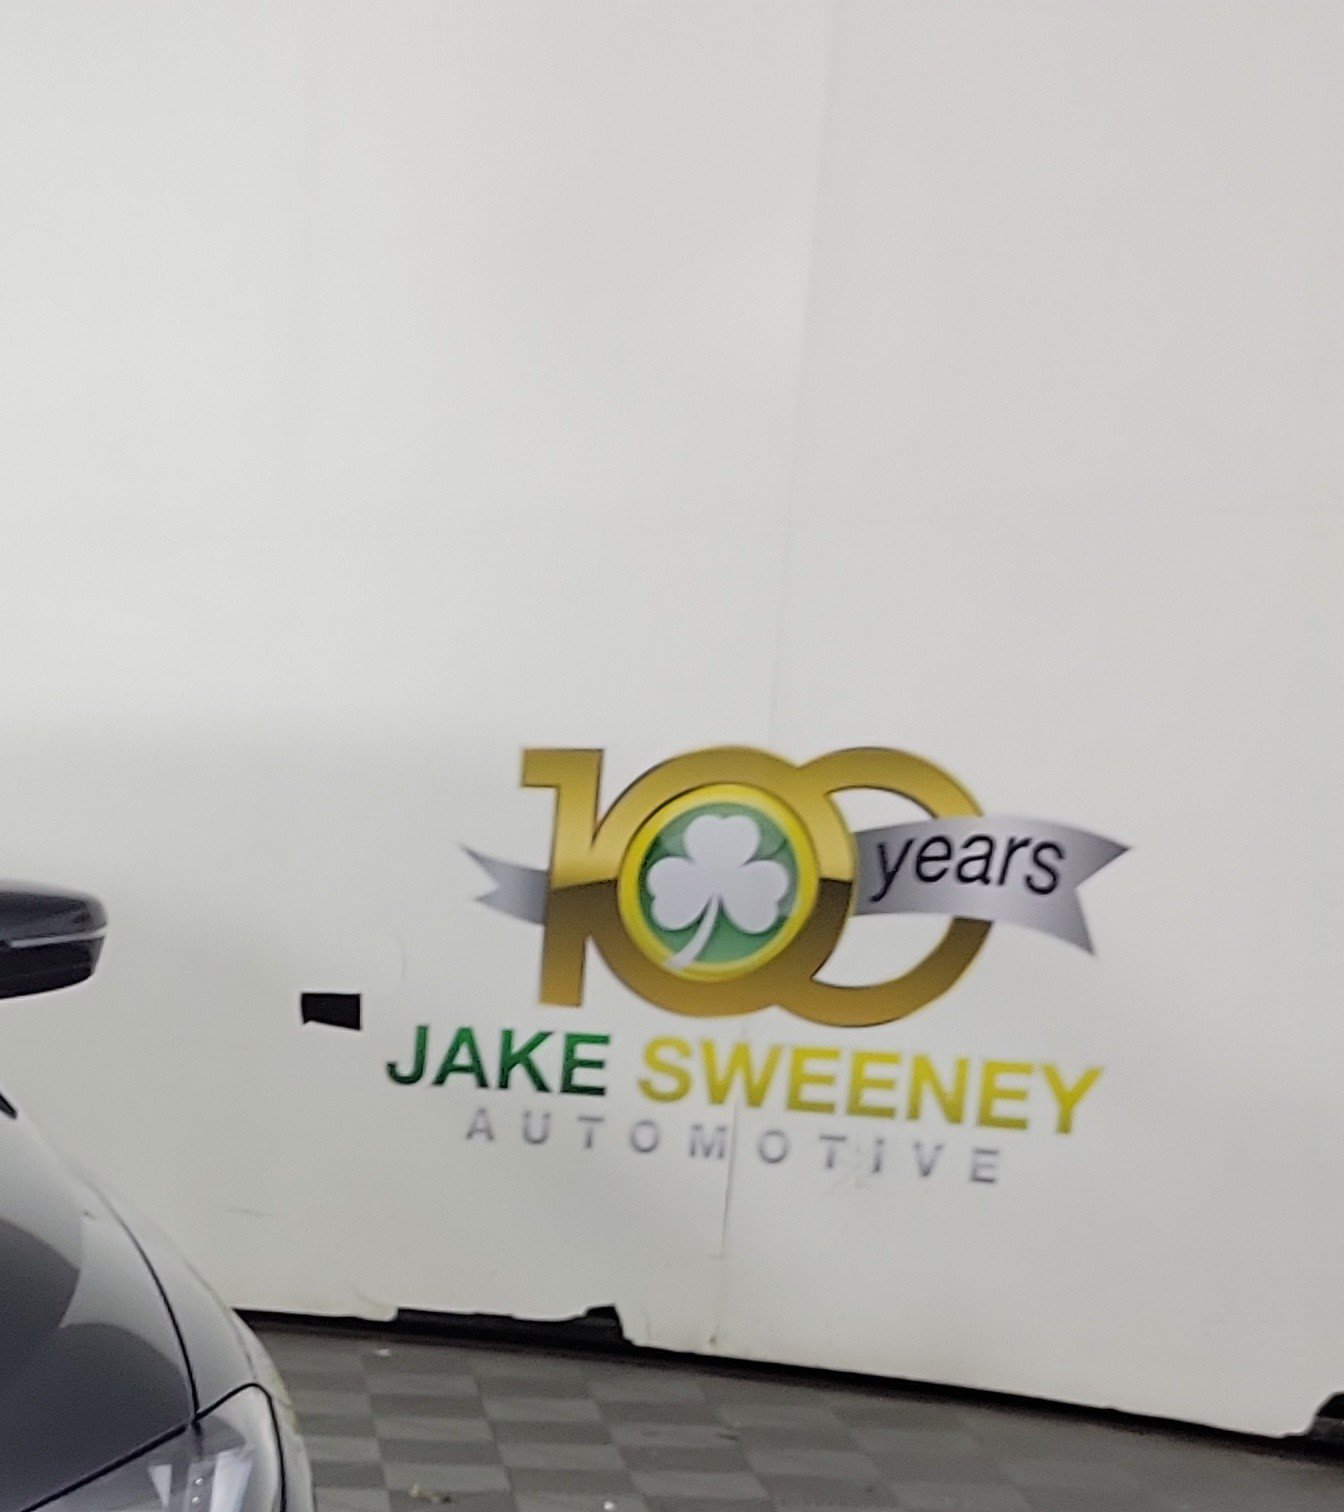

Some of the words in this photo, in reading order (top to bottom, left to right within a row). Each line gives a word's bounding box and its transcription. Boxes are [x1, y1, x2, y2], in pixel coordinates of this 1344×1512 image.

[521, 745, 994, 1028] 100
[871, 833, 1067, 902] years
[386, 1024, 611, 1097] JAKE
[637, 1037, 1102, 1135] SWEENEY
[466, 1107, 1001, 1184] AUTOMOTIVE
